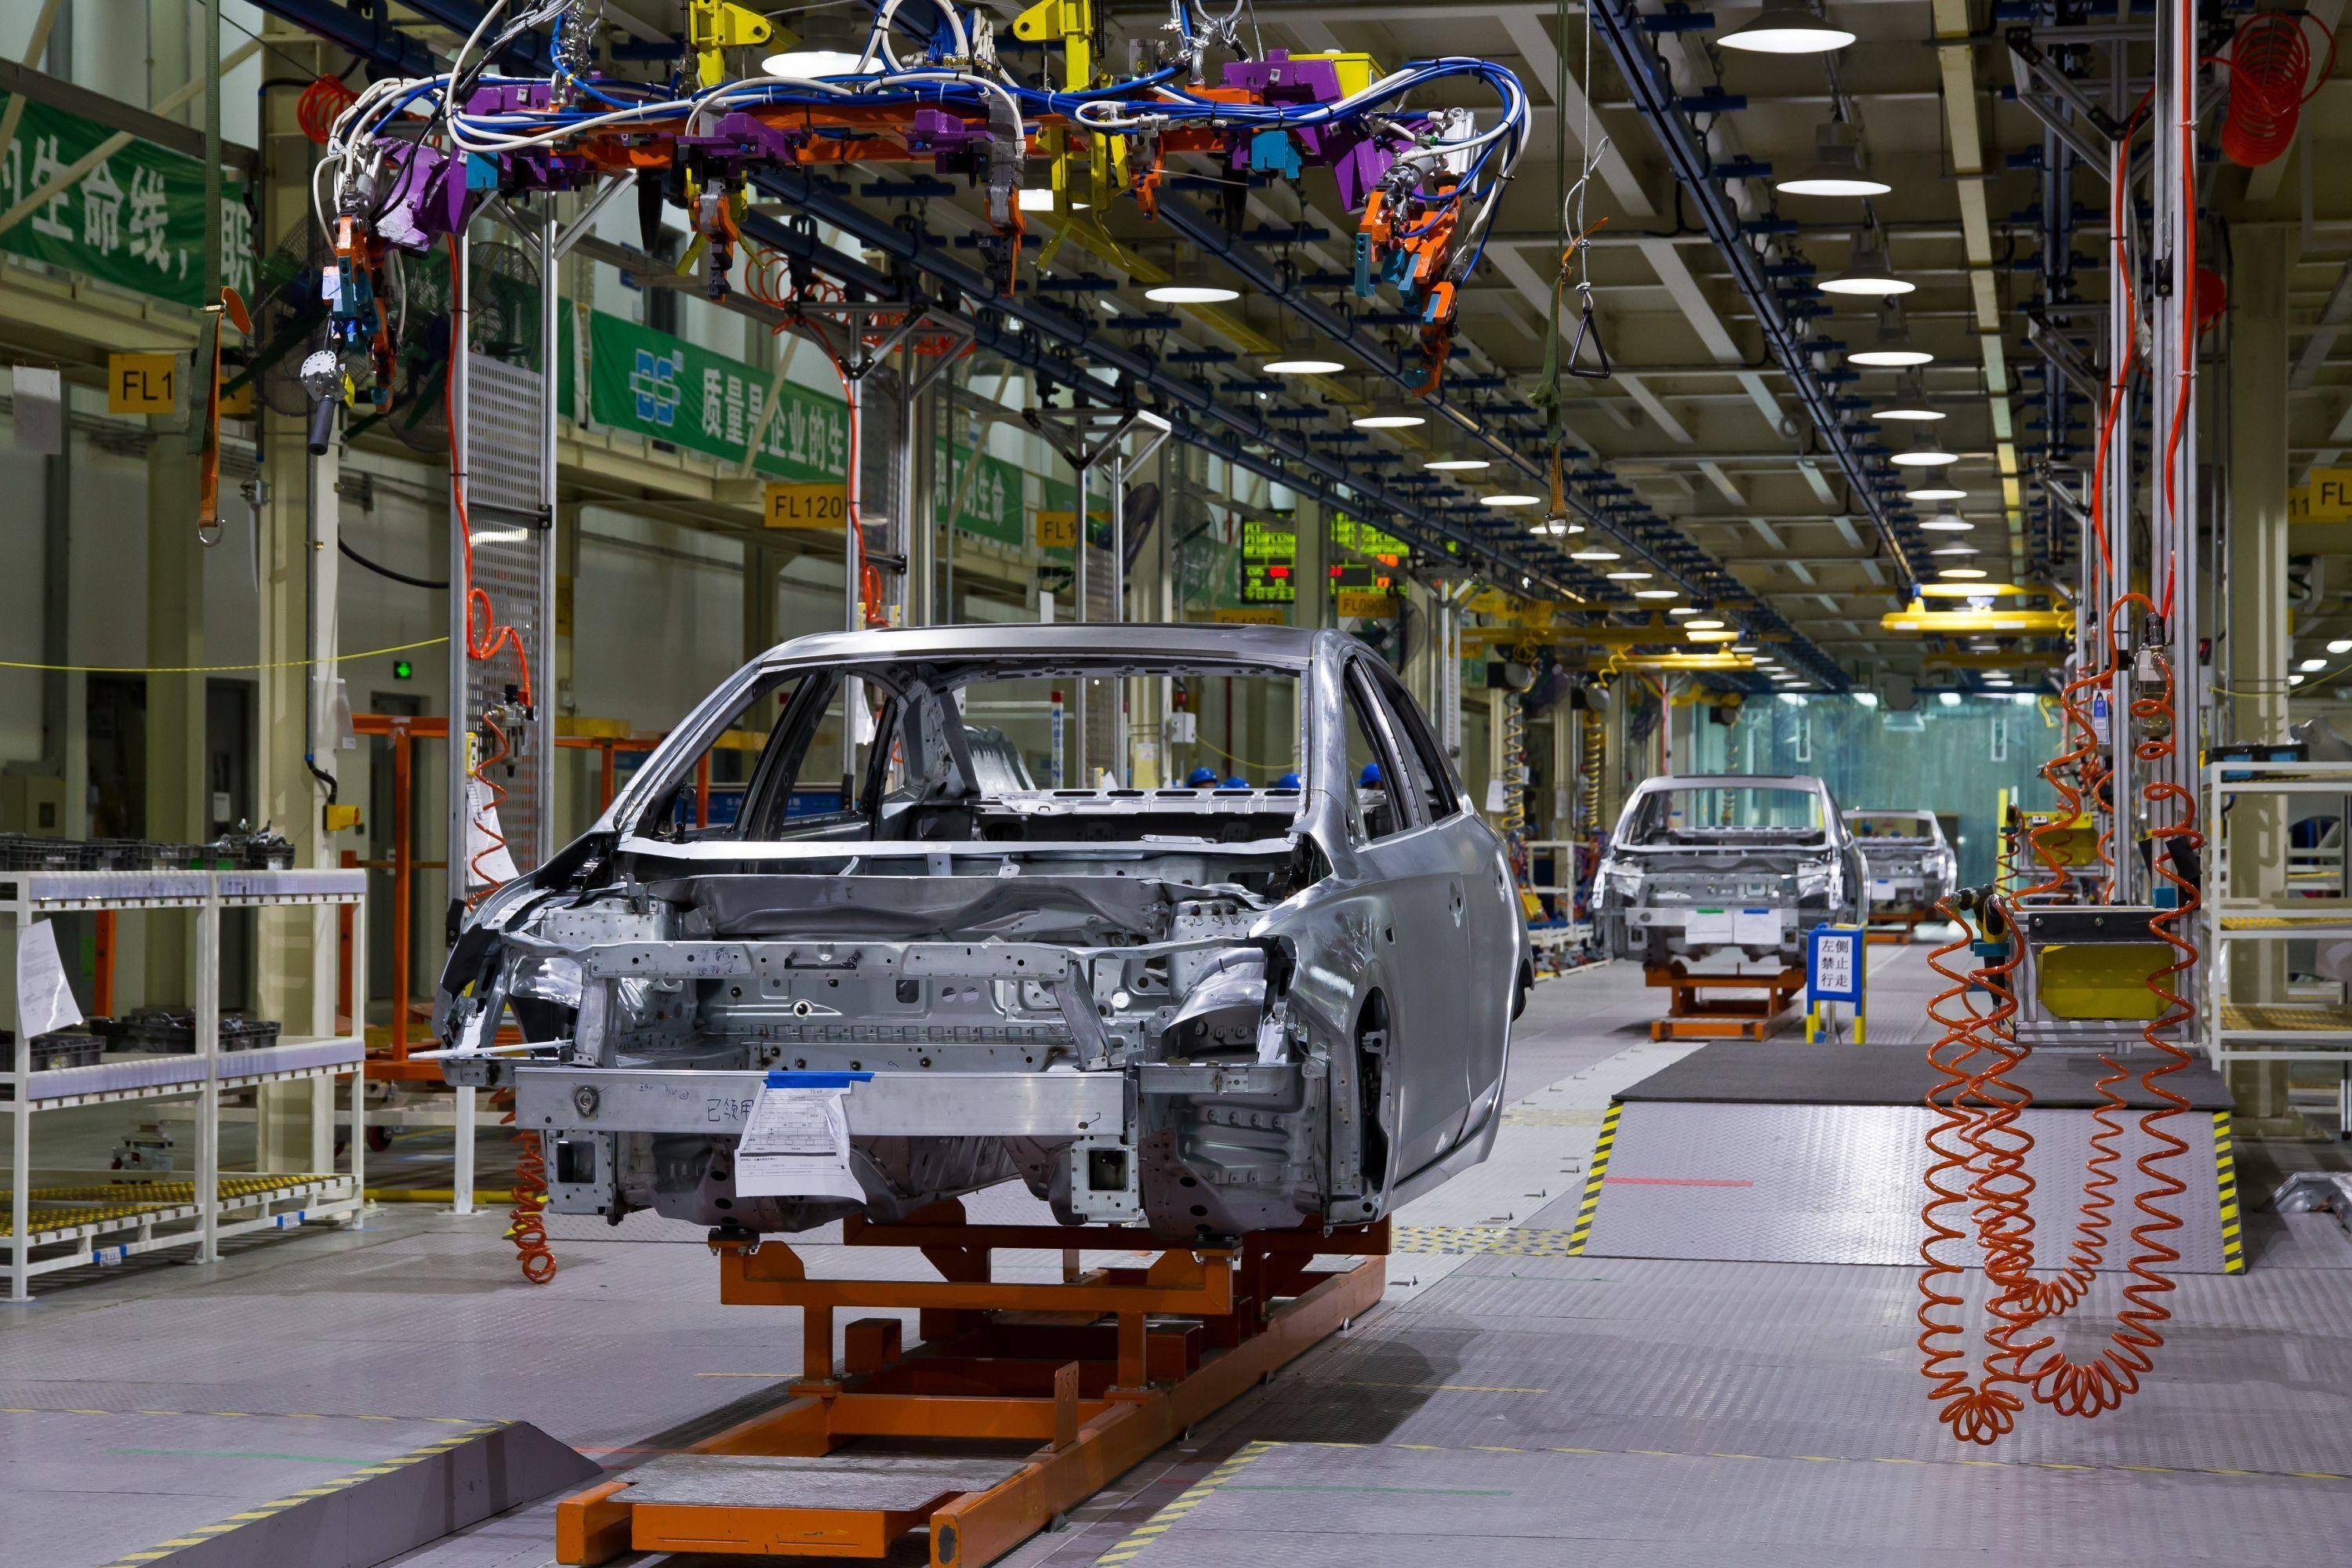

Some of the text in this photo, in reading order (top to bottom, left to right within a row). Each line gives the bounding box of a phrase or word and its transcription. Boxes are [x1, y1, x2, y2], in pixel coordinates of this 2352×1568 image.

[702, 367, 846, 477] 质量是企业的生
[775, 495, 848, 518] FL120
[1822, 939, 1849, 953] 左侧
[1821, 956, 1849, 970] 禁止
[1821, 973, 1848, 987] 行走
